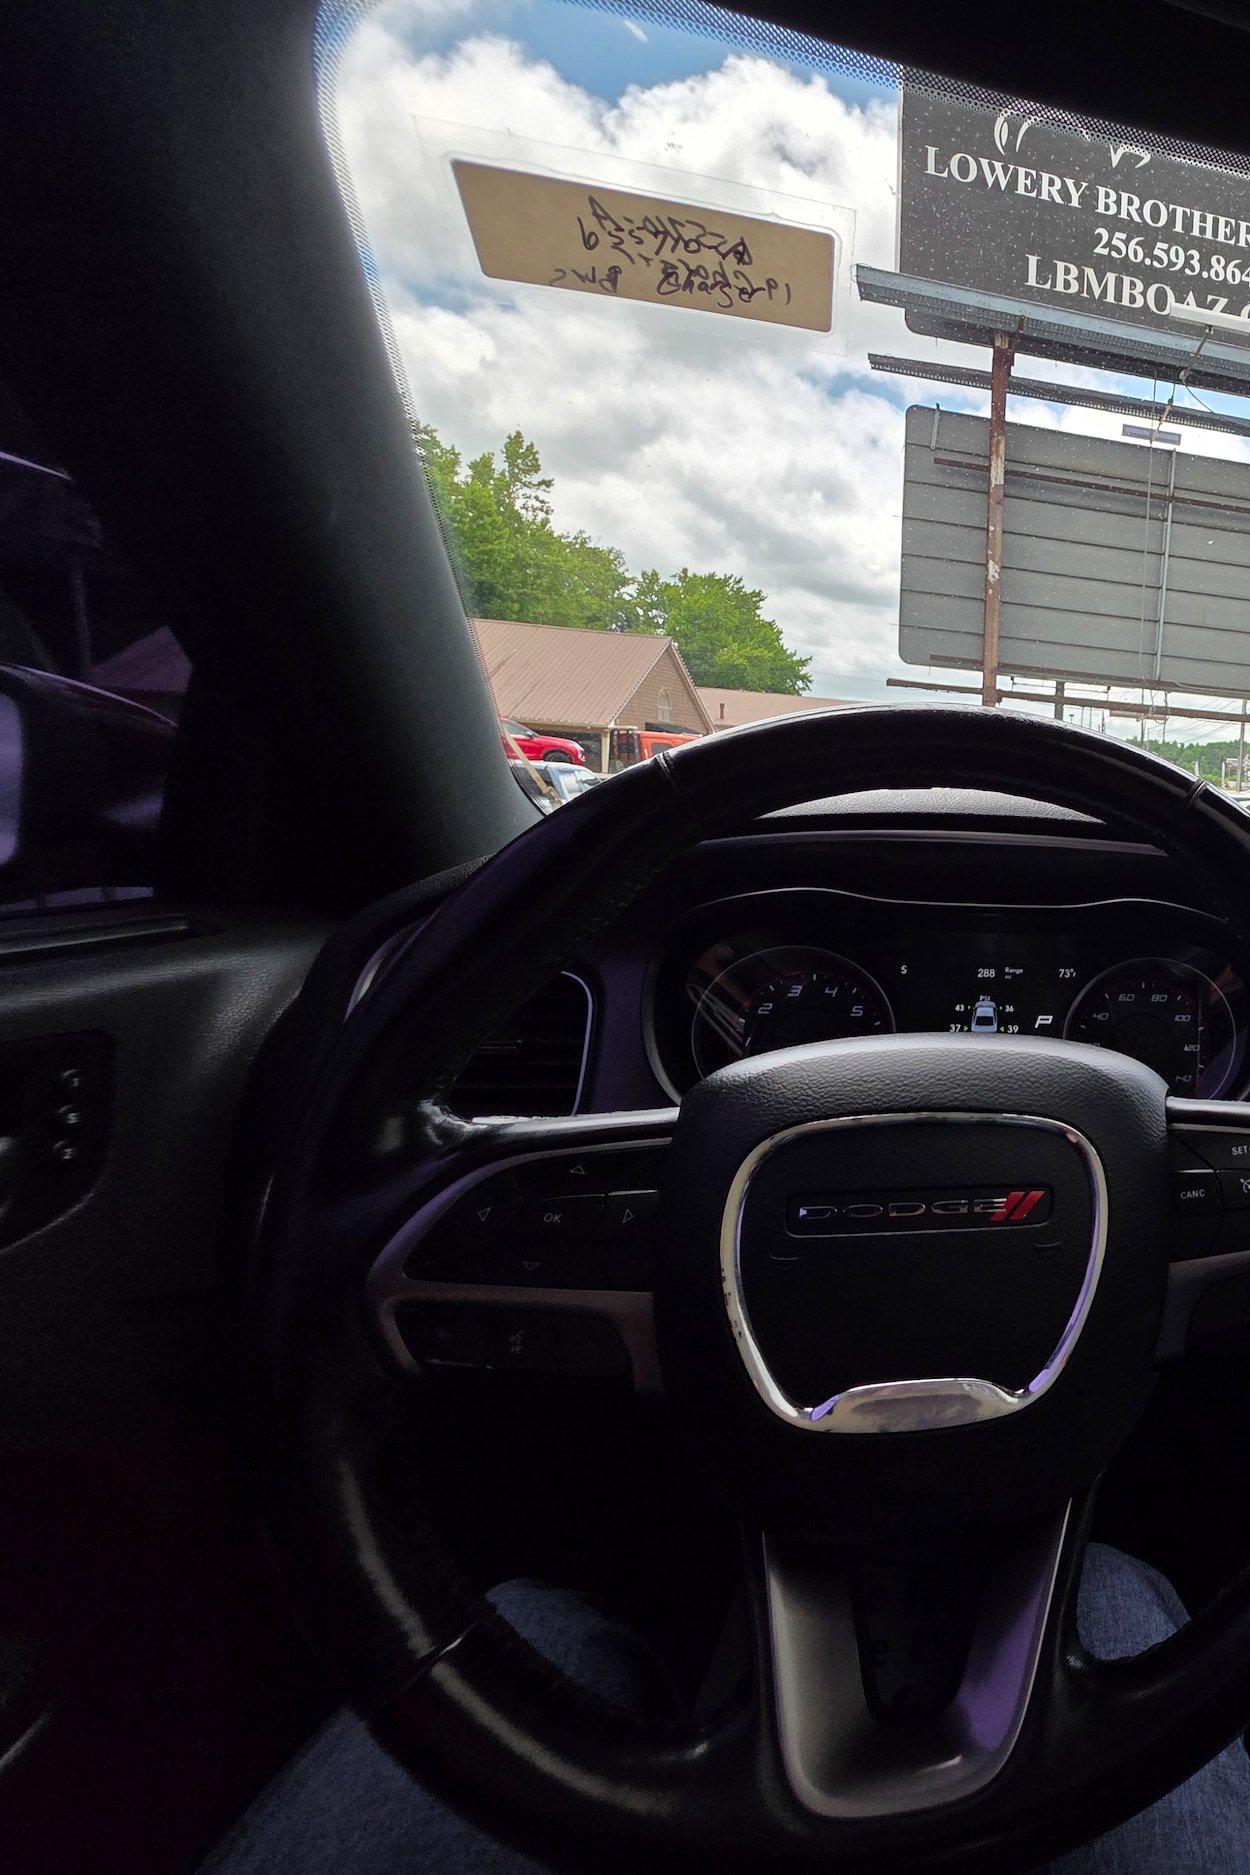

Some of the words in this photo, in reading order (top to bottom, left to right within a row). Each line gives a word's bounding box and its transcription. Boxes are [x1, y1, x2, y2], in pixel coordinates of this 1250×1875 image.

[925, 145, 1089, 208] LOWERY
[976, 968, 996, 979] 288
[787, 984, 804, 998] 3
[824, 986, 839, 998] 4
[1118, 993, 1136, 1002] 60
[1150, 993, 1169, 1003] 80
[757, 1002, 774, 1015] 2
[850, 1005, 864, 1017] 5
[954, 1003, 965, 1012] 43
[1004, 1004, 1015, 1013] 36
[1034, 1014, 1054, 1029] P
[949, 1023, 961, 1033] 37
[1006, 1024, 1020, 1034] 39
[1180, 1188, 1206, 1200] CANC
[799, 1197, 1008, 1221] DODGE
[543, 1212, 562, 1224] OK
